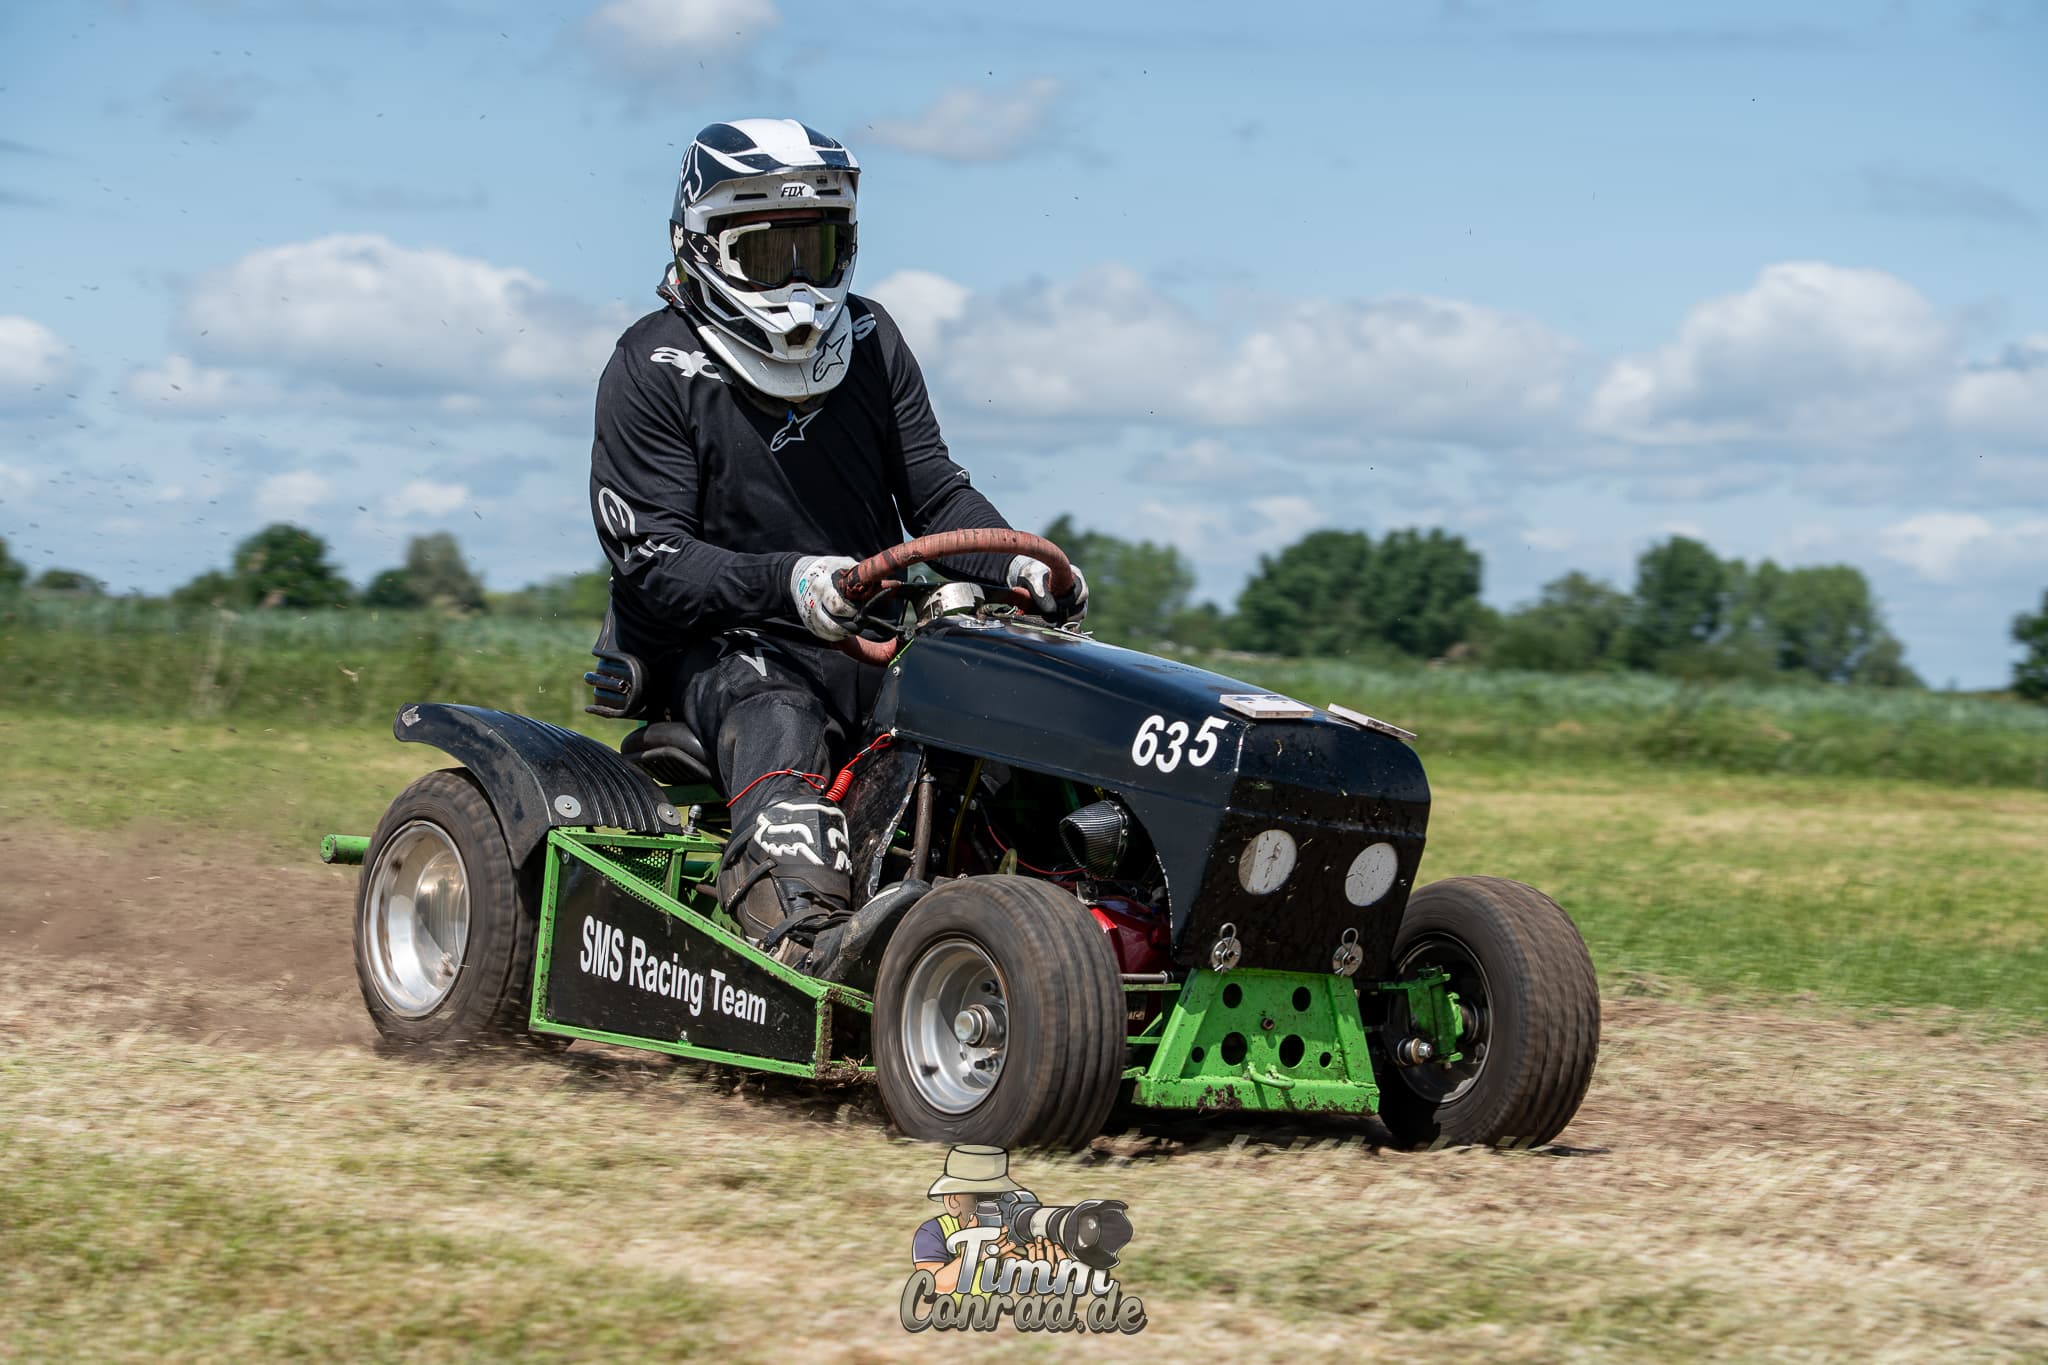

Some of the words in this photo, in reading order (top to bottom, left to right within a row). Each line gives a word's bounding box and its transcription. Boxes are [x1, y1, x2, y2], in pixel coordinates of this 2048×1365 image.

[781, 185, 806, 198] FOX
[1132, 714, 1229, 773] 635
[580, 915, 624, 982] SMS
[629, 936, 703, 1017] Racing
[710, 969, 767, 1025] Team
